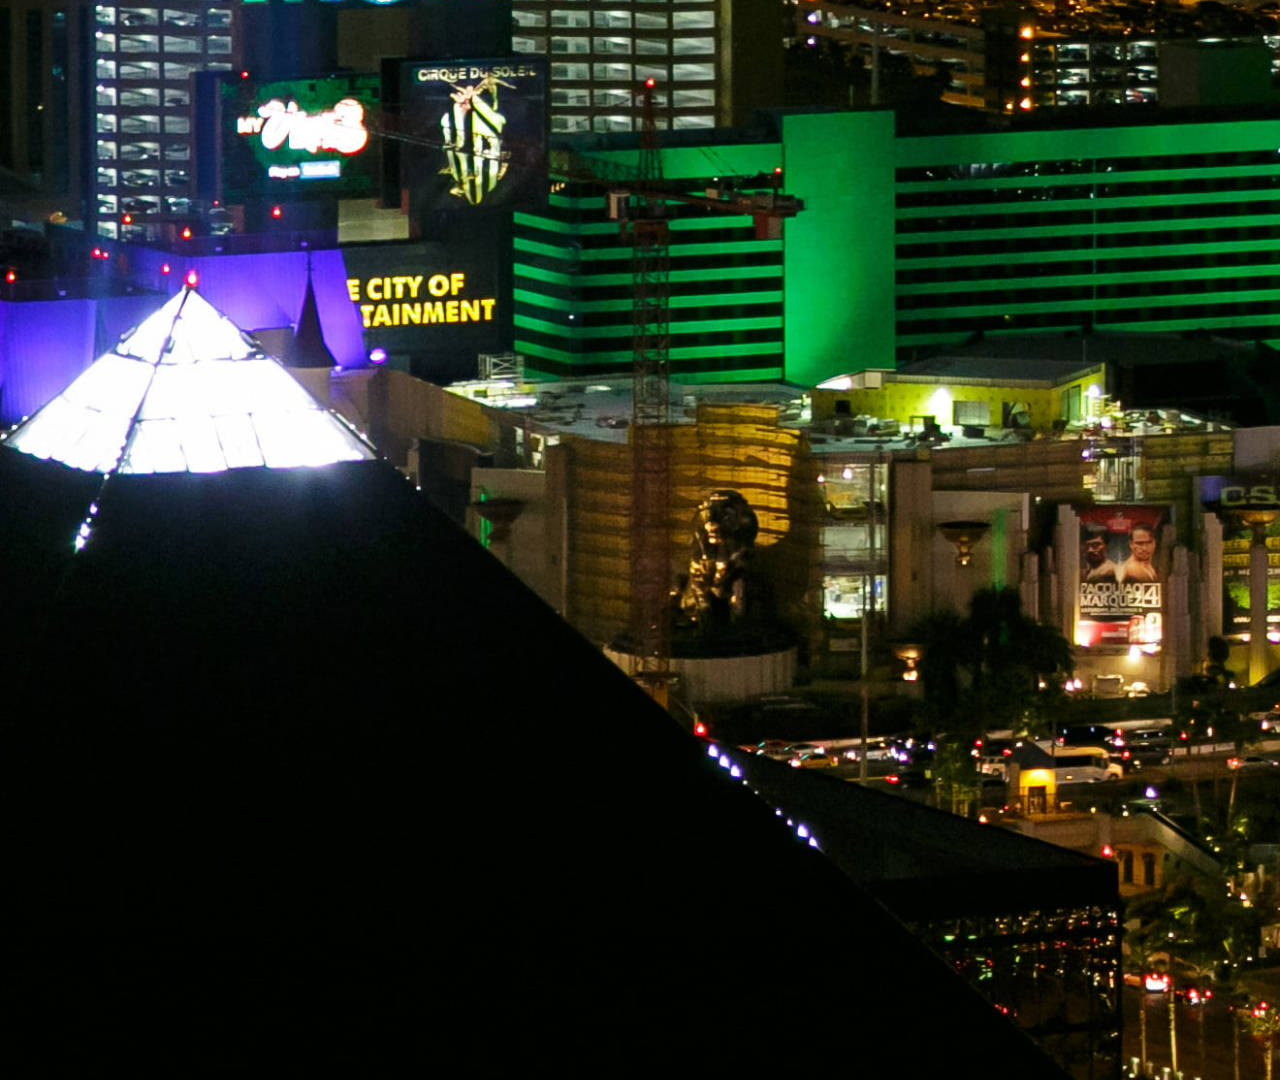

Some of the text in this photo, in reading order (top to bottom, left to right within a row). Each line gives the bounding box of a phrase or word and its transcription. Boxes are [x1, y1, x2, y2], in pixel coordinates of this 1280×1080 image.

[418, 68, 467, 82] CIRQUE
[366, 275, 423, 301] CITY
[428, 272, 465, 297] OF
[1080, 582, 1142, 594] PACQUIAO
[1080, 594, 1143, 608] MARQUEZ
